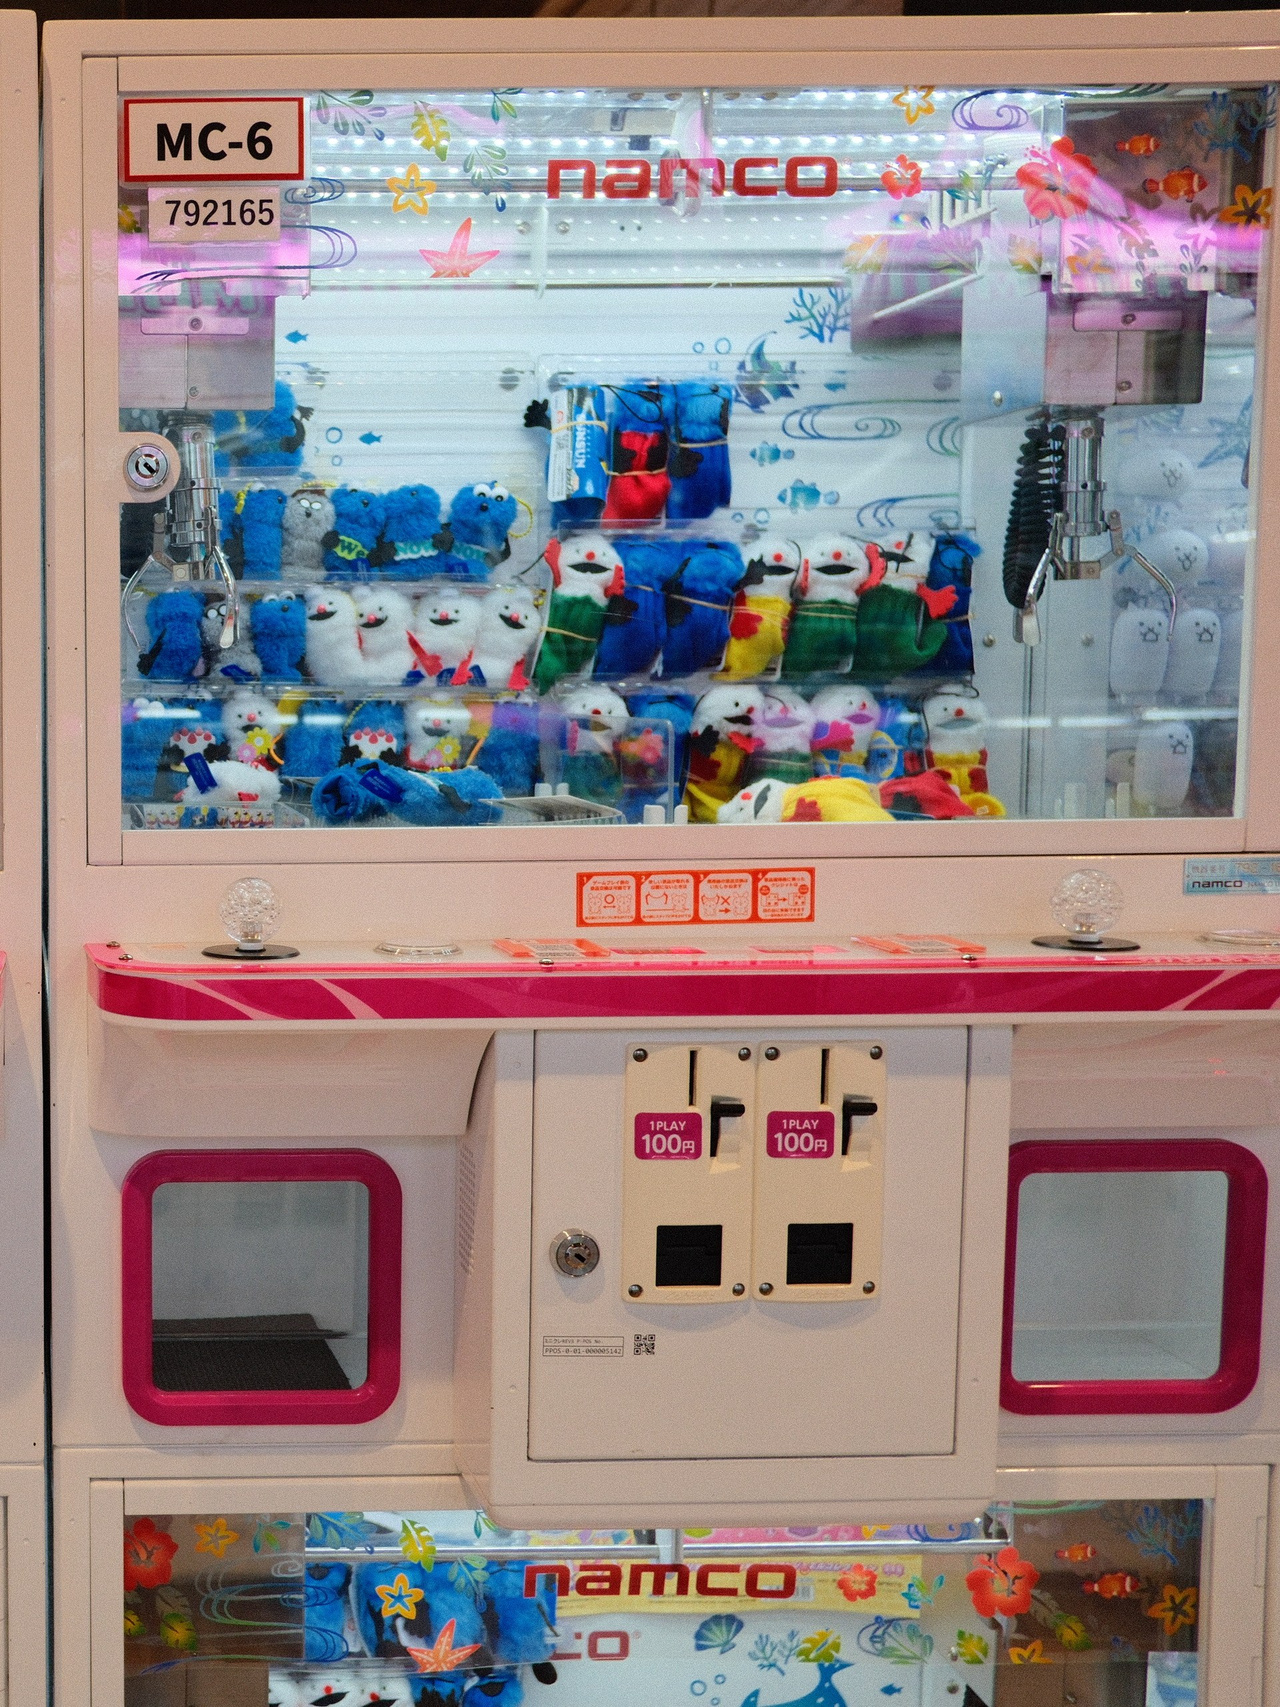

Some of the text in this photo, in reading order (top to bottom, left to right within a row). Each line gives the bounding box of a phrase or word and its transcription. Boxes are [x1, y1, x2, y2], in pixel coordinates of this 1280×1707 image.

[156, 122, 273, 161] MC-6
[547, 156, 838, 199] namco
[165, 199, 274, 226] 792165
[1192, 880, 1243, 888] namco
[649, 1121, 686, 1131] 1PLAY
[782, 1119, 819, 1130] 1PLAY
[641, 1134, 695, 1154] 100円
[774, 1133, 827, 1152] 100円
[524, 1563, 797, 1598] namco
